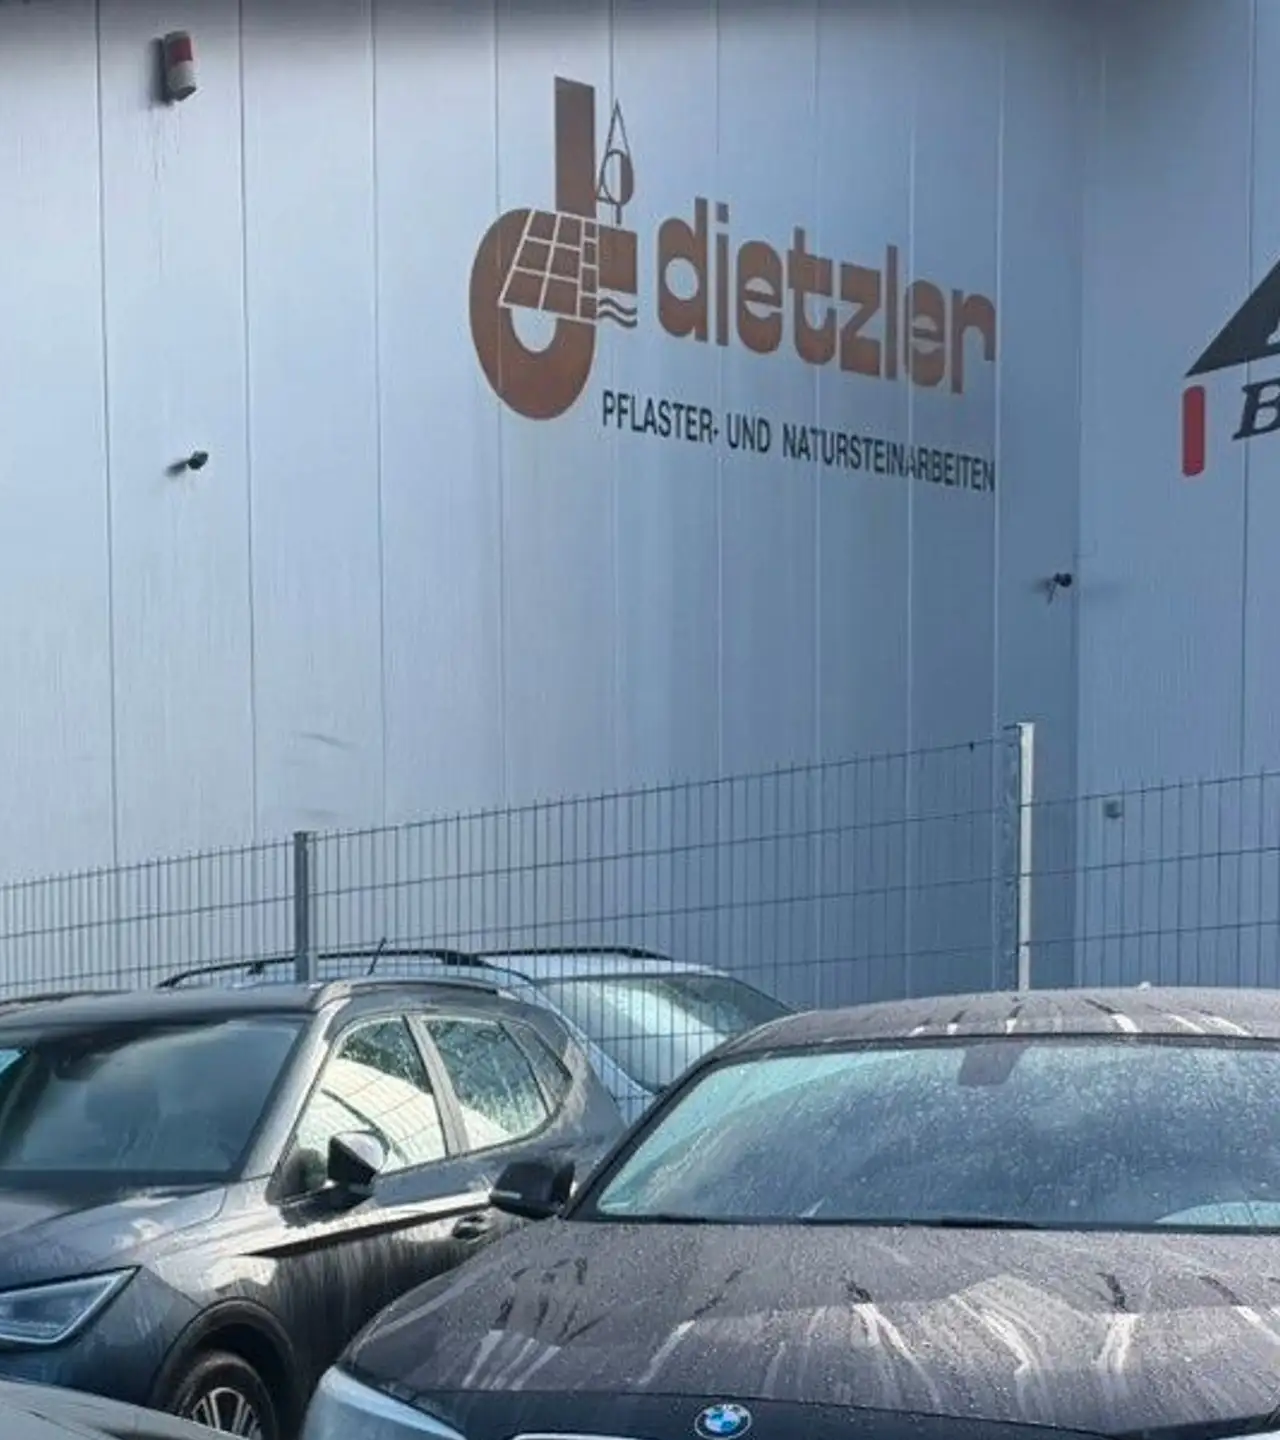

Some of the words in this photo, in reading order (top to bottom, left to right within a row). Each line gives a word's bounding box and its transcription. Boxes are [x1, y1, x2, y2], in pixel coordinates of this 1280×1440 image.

[657, 196, 997, 395] dietzler
[602, 389, 719, 445] PFLASTER-
[727, 413, 771, 454] UND
[783, 422, 996, 492] NATURSTEINARBEITEN
